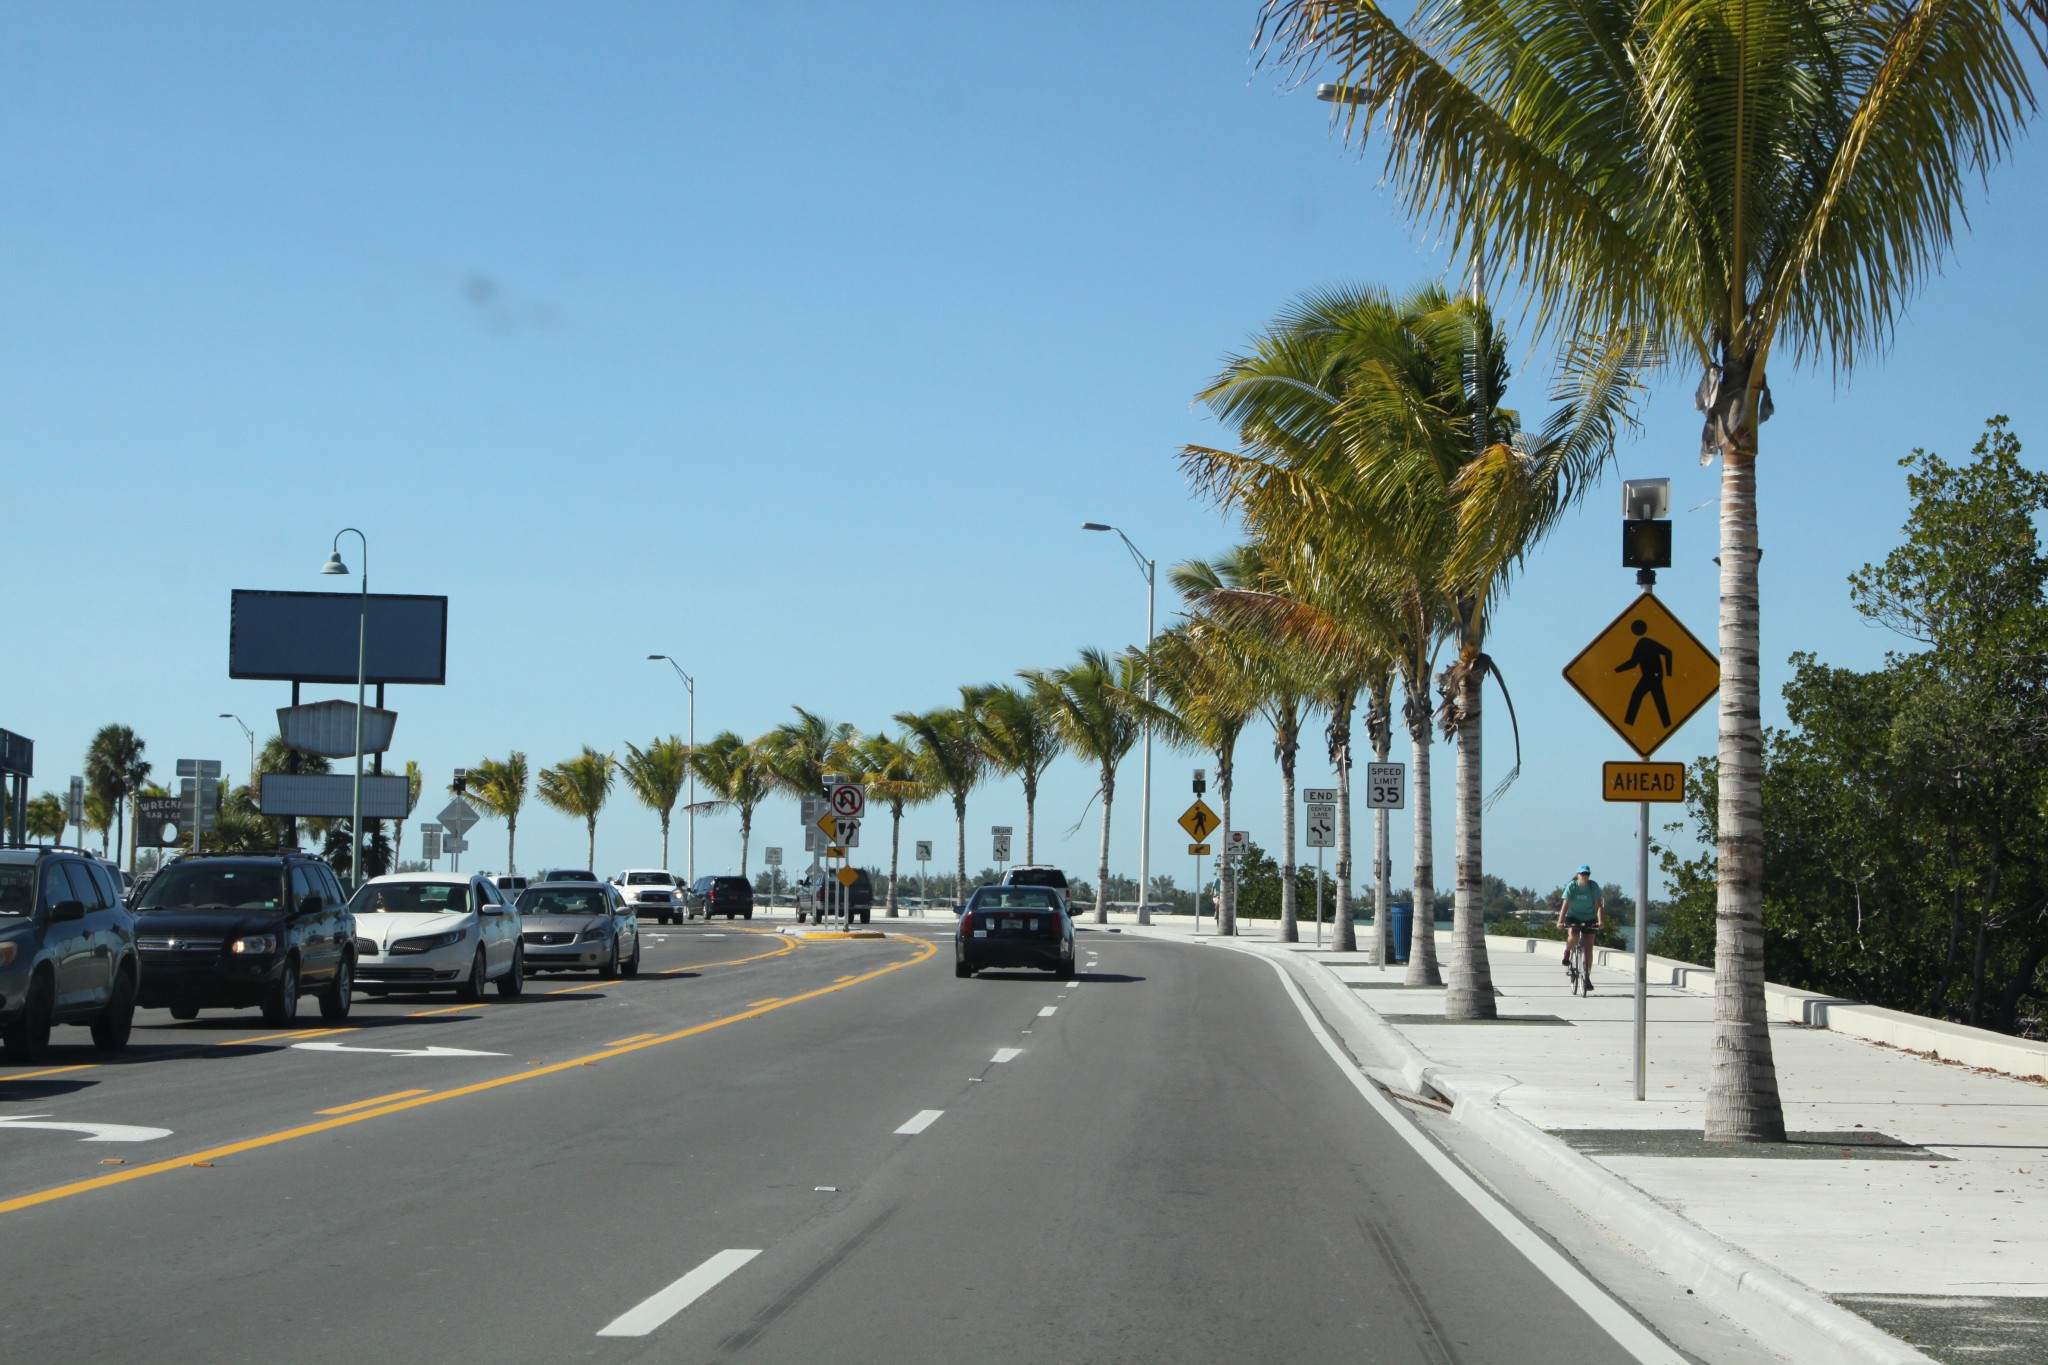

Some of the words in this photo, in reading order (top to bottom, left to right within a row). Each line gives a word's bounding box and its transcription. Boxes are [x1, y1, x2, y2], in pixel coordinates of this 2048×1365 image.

[1613, 773, 1675, 791] AHEAD
[1310, 792, 1333, 800] END
[1373, 787, 1399, 803] 35
[146, 811, 162, 819] BAR
